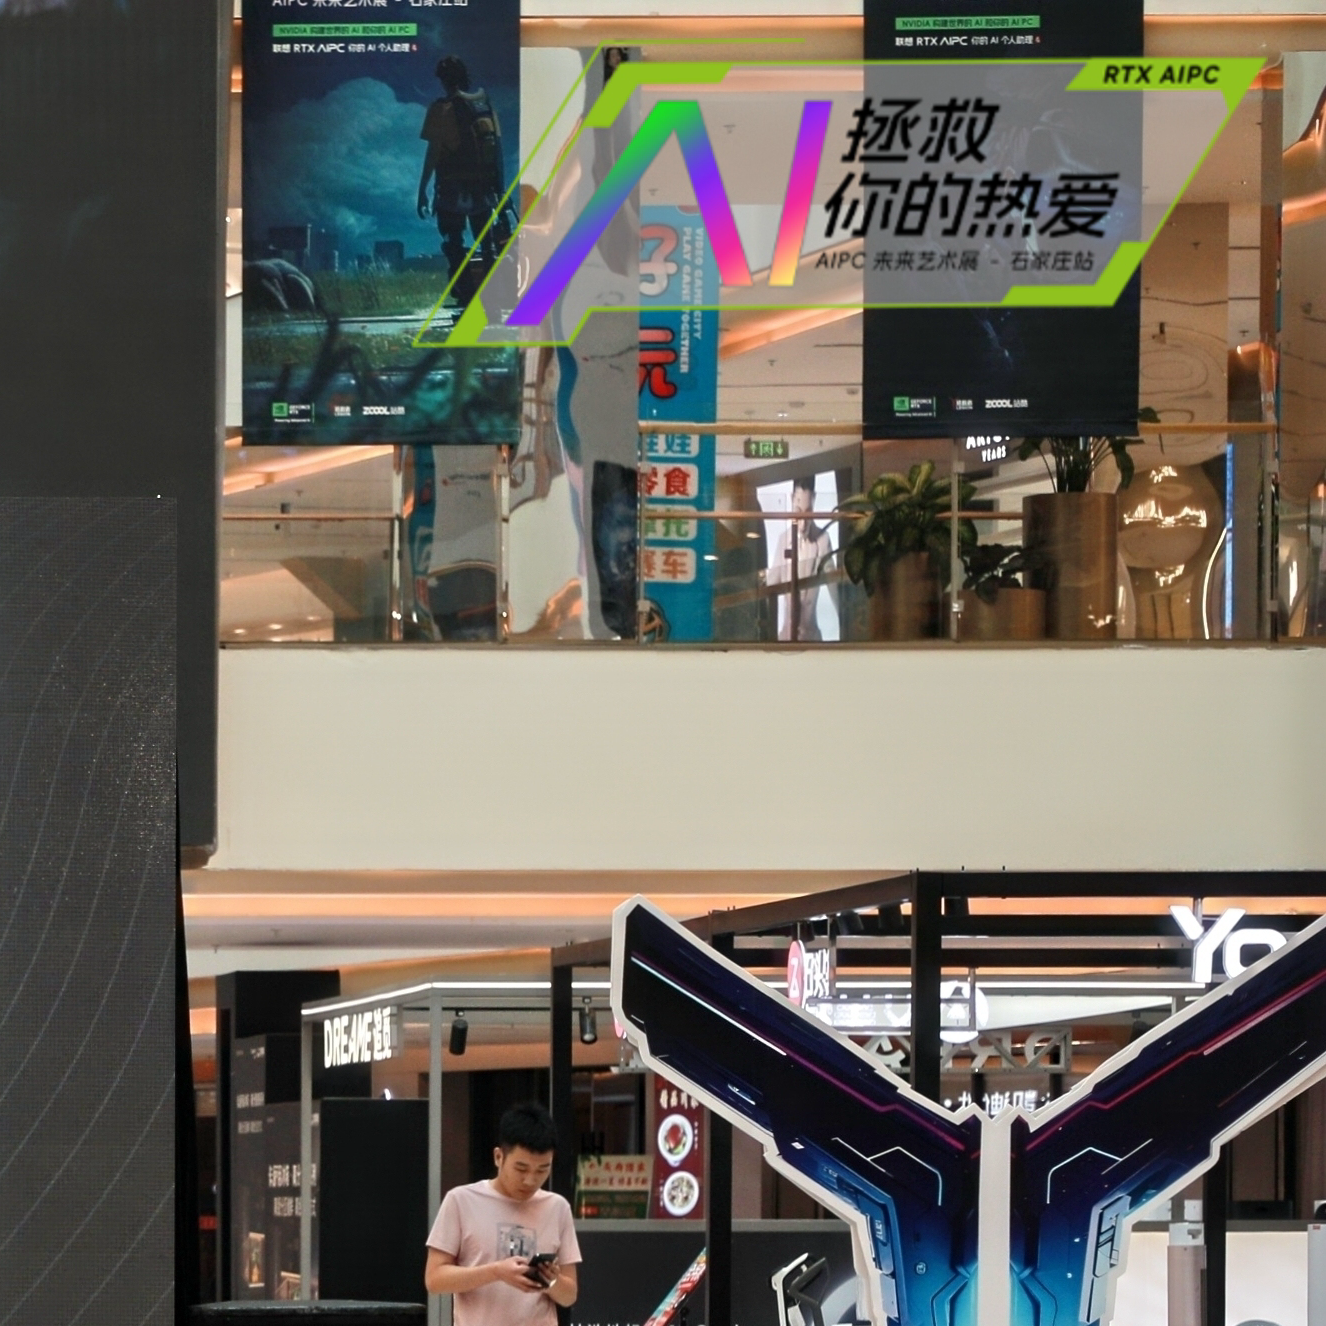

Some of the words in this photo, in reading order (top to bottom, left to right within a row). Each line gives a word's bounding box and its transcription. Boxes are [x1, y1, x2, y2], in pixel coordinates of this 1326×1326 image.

[916, 37, 938, 46] RTX
[990, 36, 999, 45] AI
[323, 1011, 373, 1069] DREAME
